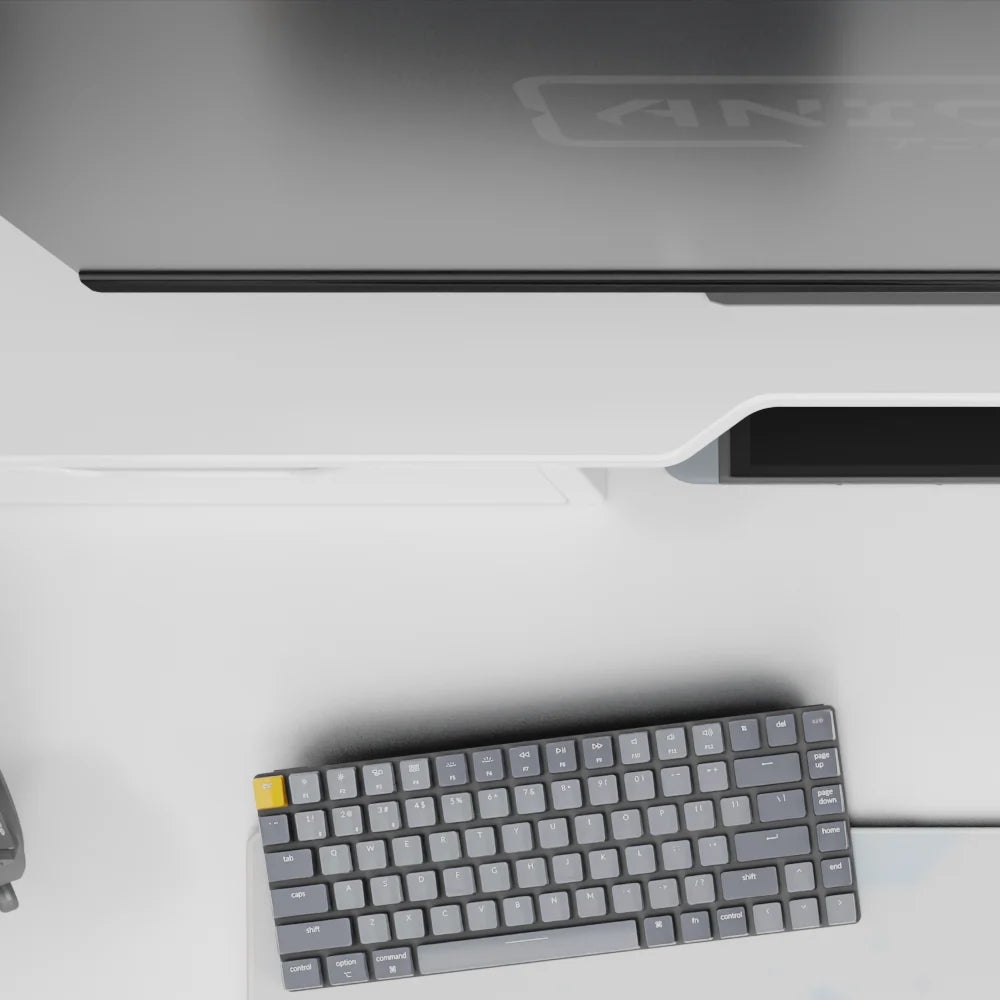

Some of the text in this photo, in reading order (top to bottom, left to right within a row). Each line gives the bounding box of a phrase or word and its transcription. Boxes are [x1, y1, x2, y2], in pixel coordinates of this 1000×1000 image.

[775, 719, 787, 728] del
[813, 752, 830, 761] page
[817, 788, 834, 797] page
[818, 797, 838, 805] down
[821, 827, 841, 835] home
[282, 854, 295, 863] tab
[829, 861, 843, 871] end
[741, 872, 757, 881] shift
[290, 891, 306, 899] caps
[719, 911, 743, 921] control
[305, 925, 321, 934] shift
[375, 951, 407, 963] command
[289, 963, 313, 973] control
[335, 959, 357, 968] option
